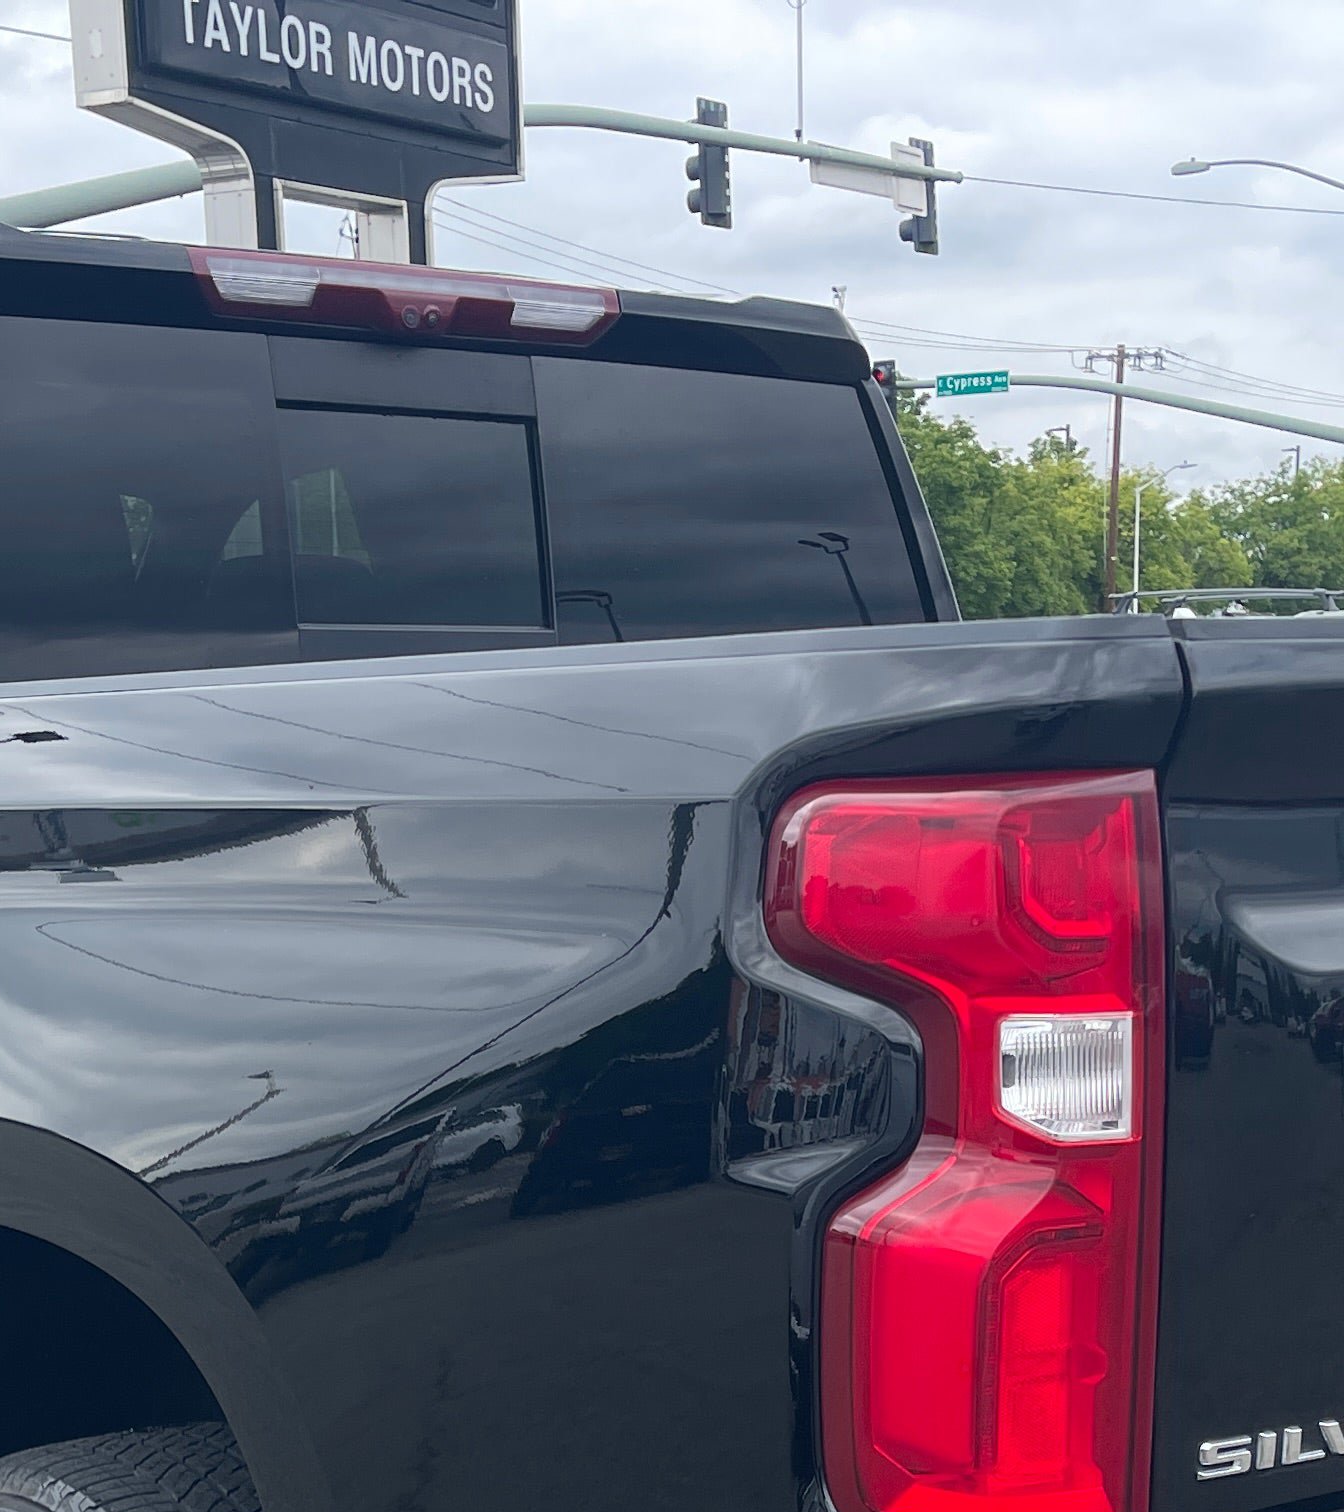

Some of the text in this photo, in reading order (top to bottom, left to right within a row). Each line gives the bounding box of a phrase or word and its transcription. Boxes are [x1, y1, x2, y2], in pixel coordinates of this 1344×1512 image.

[182, 0, 495, 114] TAYLOR MOTORS
[946, 376, 992, 391] Cypress
